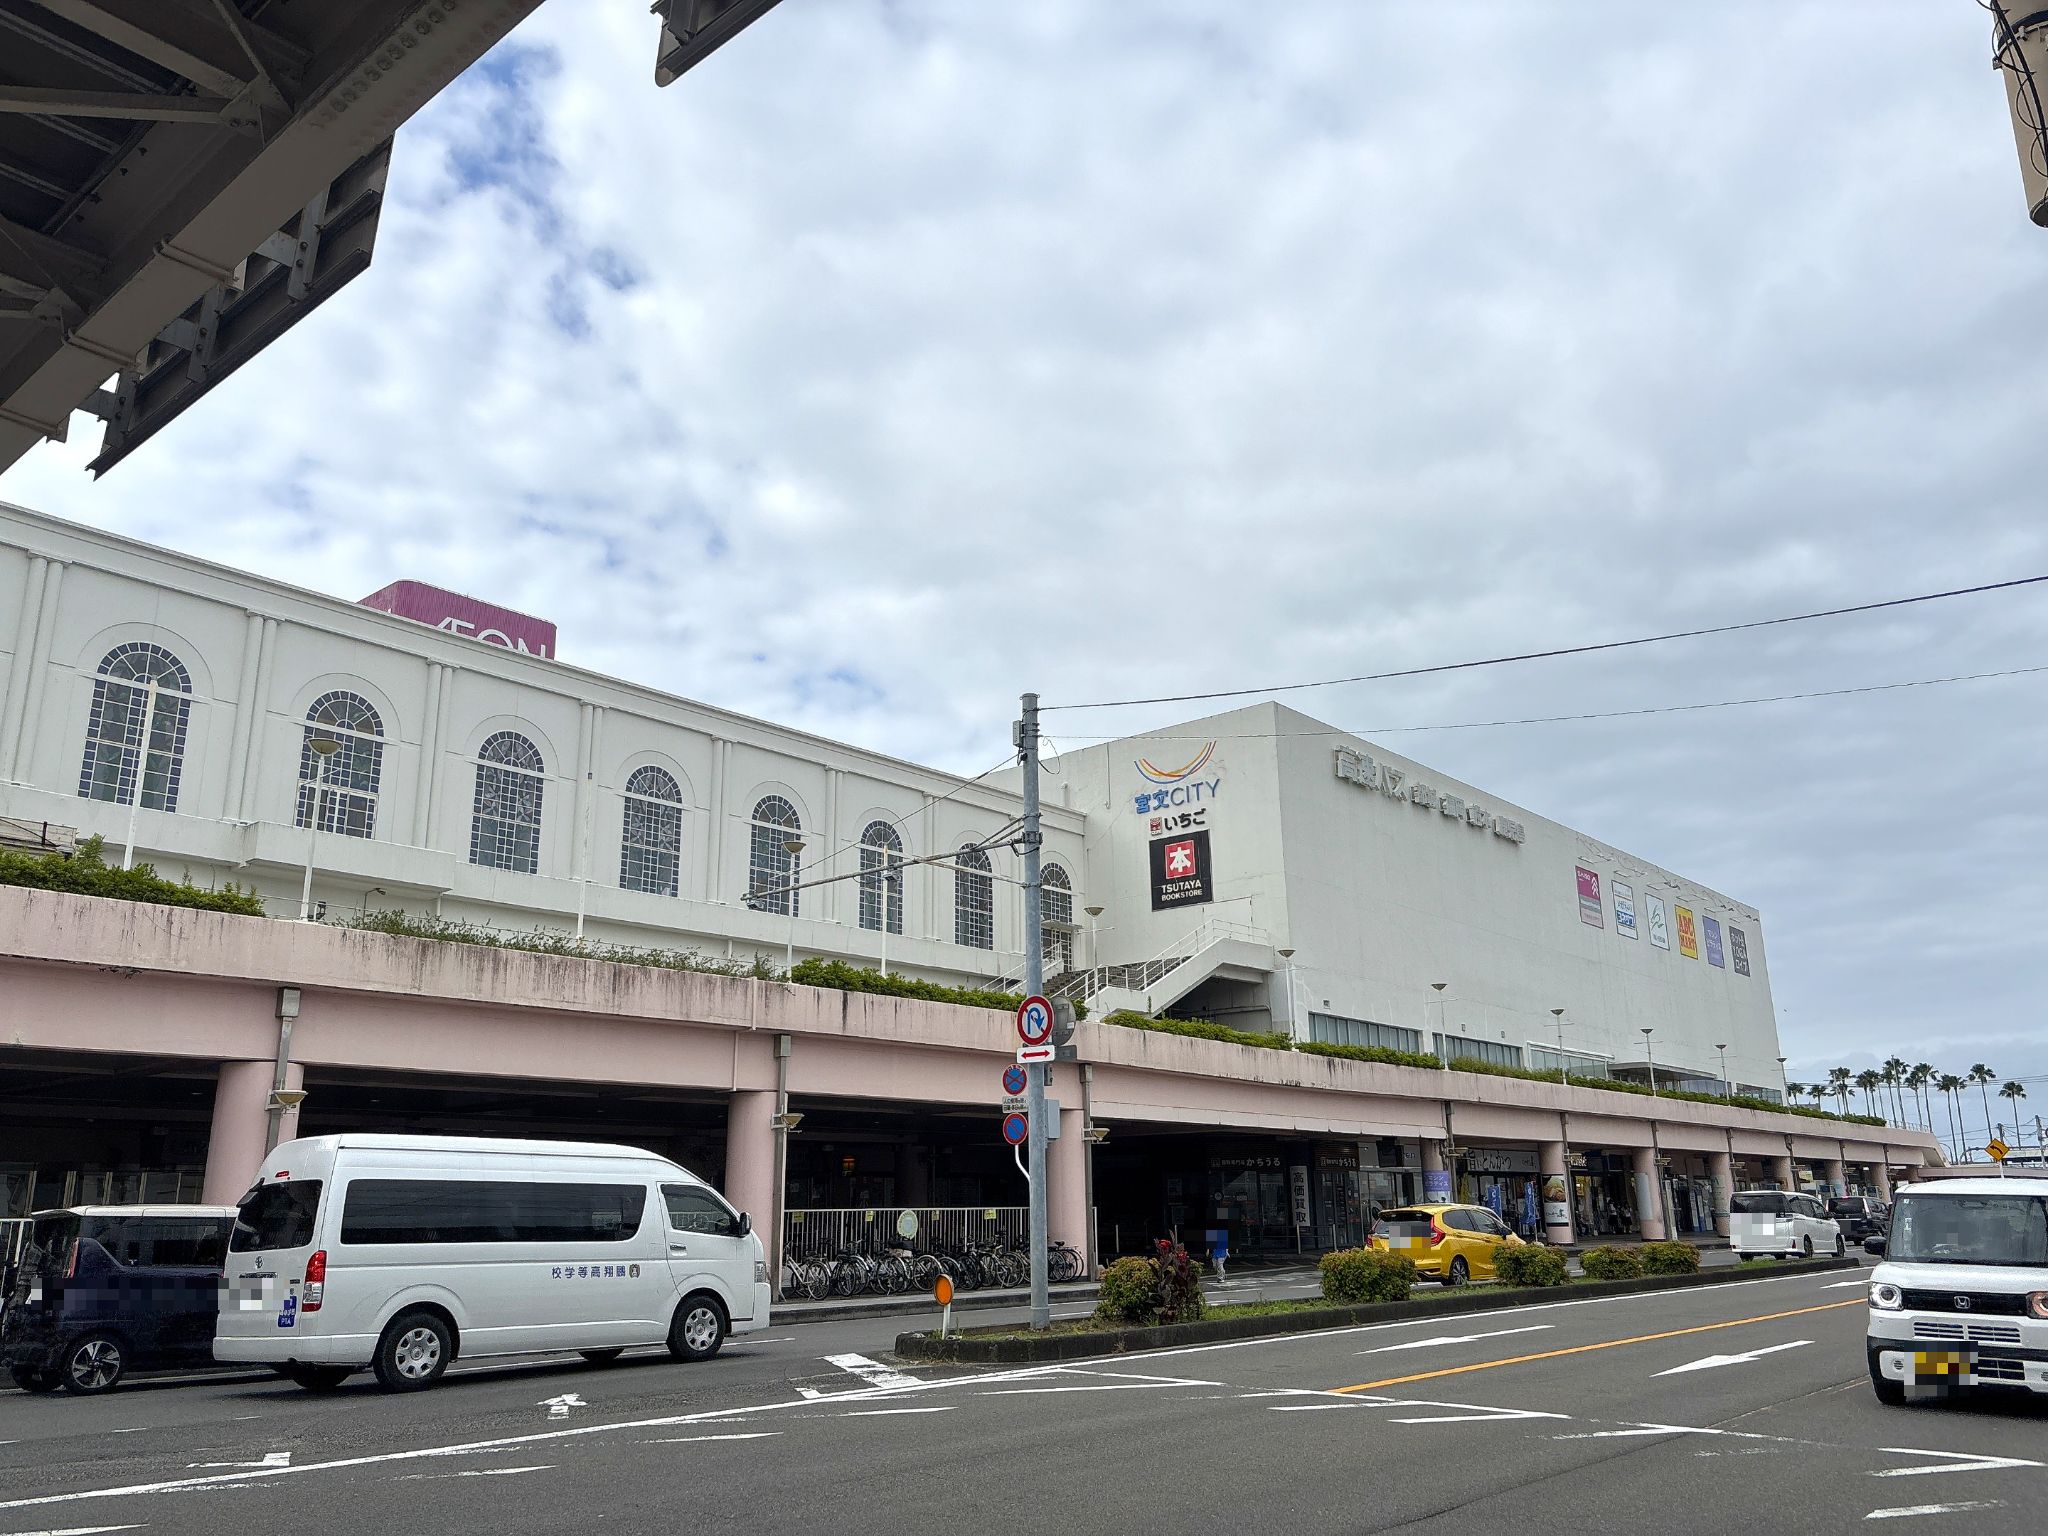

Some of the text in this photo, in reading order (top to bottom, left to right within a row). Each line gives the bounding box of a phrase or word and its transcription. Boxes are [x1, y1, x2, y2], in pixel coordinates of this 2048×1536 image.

[1164, 808, 1207, 831] いちご
[1169, 846, 1191, 873] 本
[1161, 879, 1202, 894] TSUTAYA
[1678, 912, 1694, 937] ABC
[1246, 1157, 1281, 1167] かちうる
[1293, 1171, 1307, 1223] 高価買取
